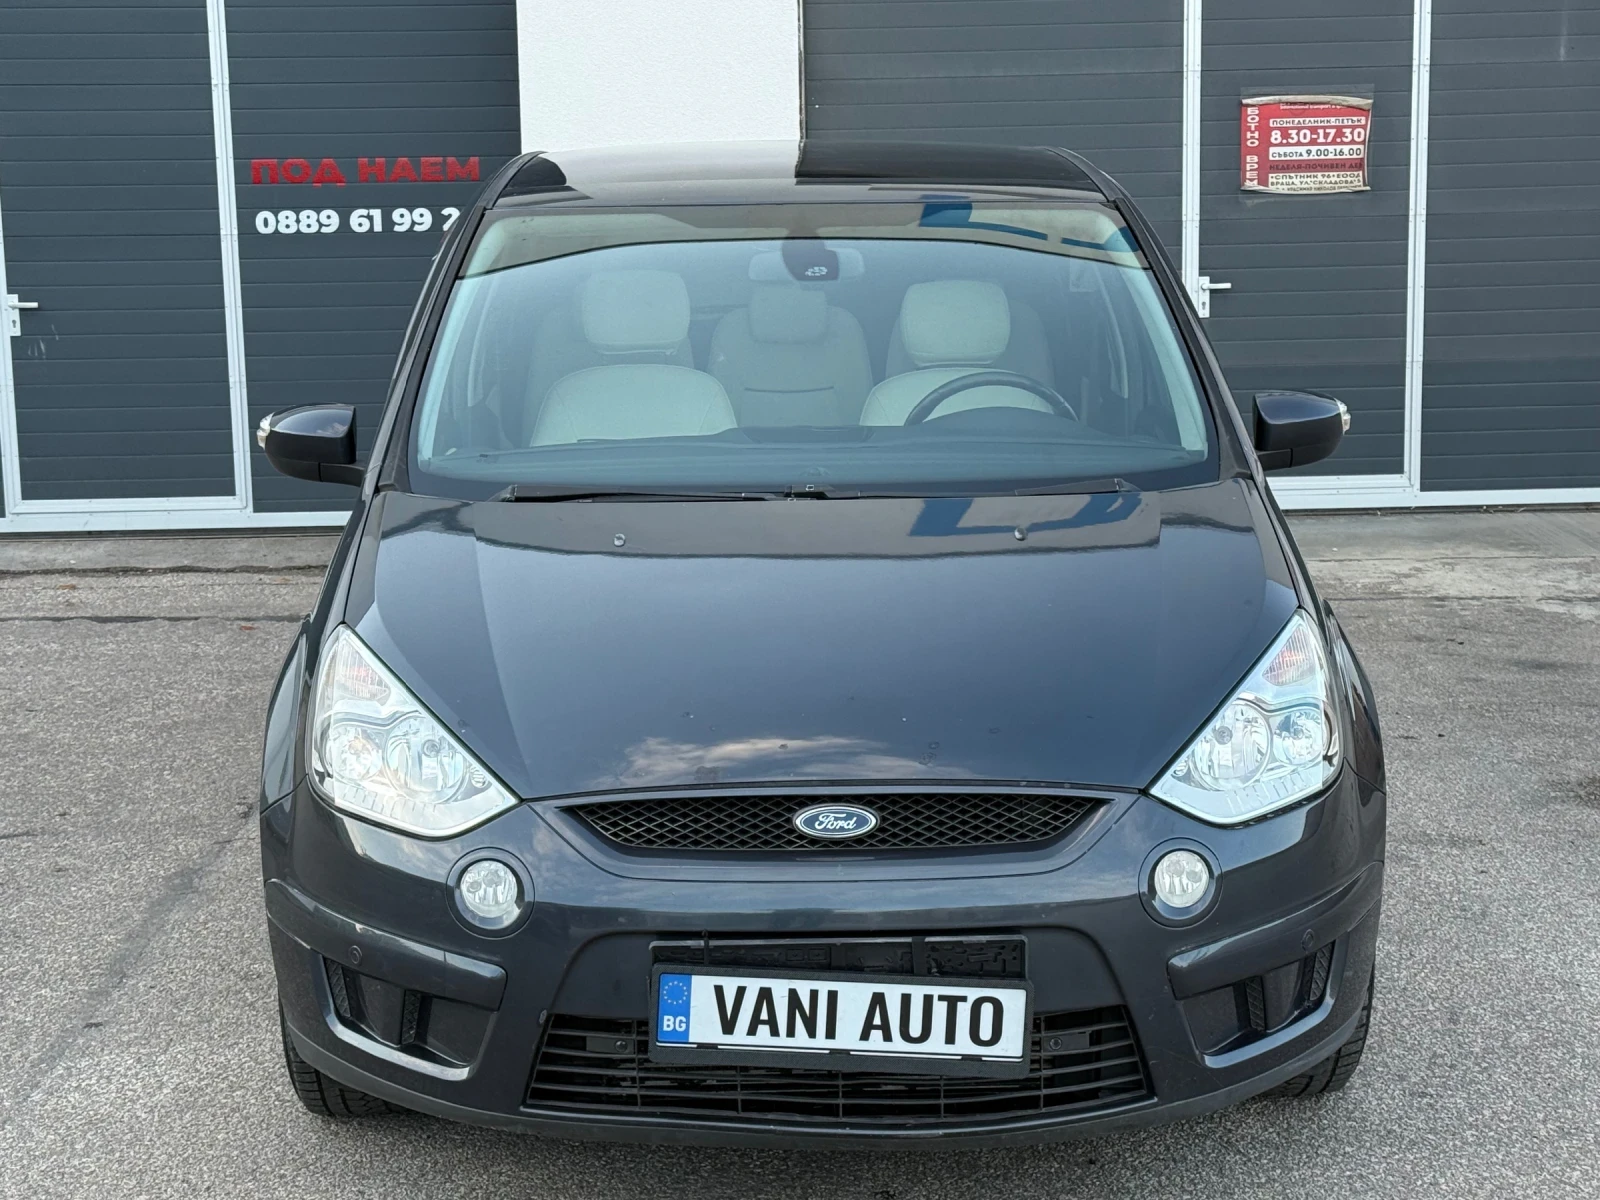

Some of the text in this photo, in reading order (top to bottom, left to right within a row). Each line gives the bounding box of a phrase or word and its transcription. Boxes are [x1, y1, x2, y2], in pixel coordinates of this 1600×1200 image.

[1272, 118, 1362, 126] ПОНЕДЕЛНИК-ПЕТЪК
[1270, 128, 1365, 144] 8.30-17.30
[1306, 147, 1362, 157] 9.00-16.00
[250, 156, 480, 188] ПОД НАЕМ
[255, 209, 340, 234] 0889
[349, 208, 382, 233] 61
[391, 207, 432, 232] 99
[814, 809, 857, 830] Ford
[663, 984, 1004, 1047] BG VANI AUTO
